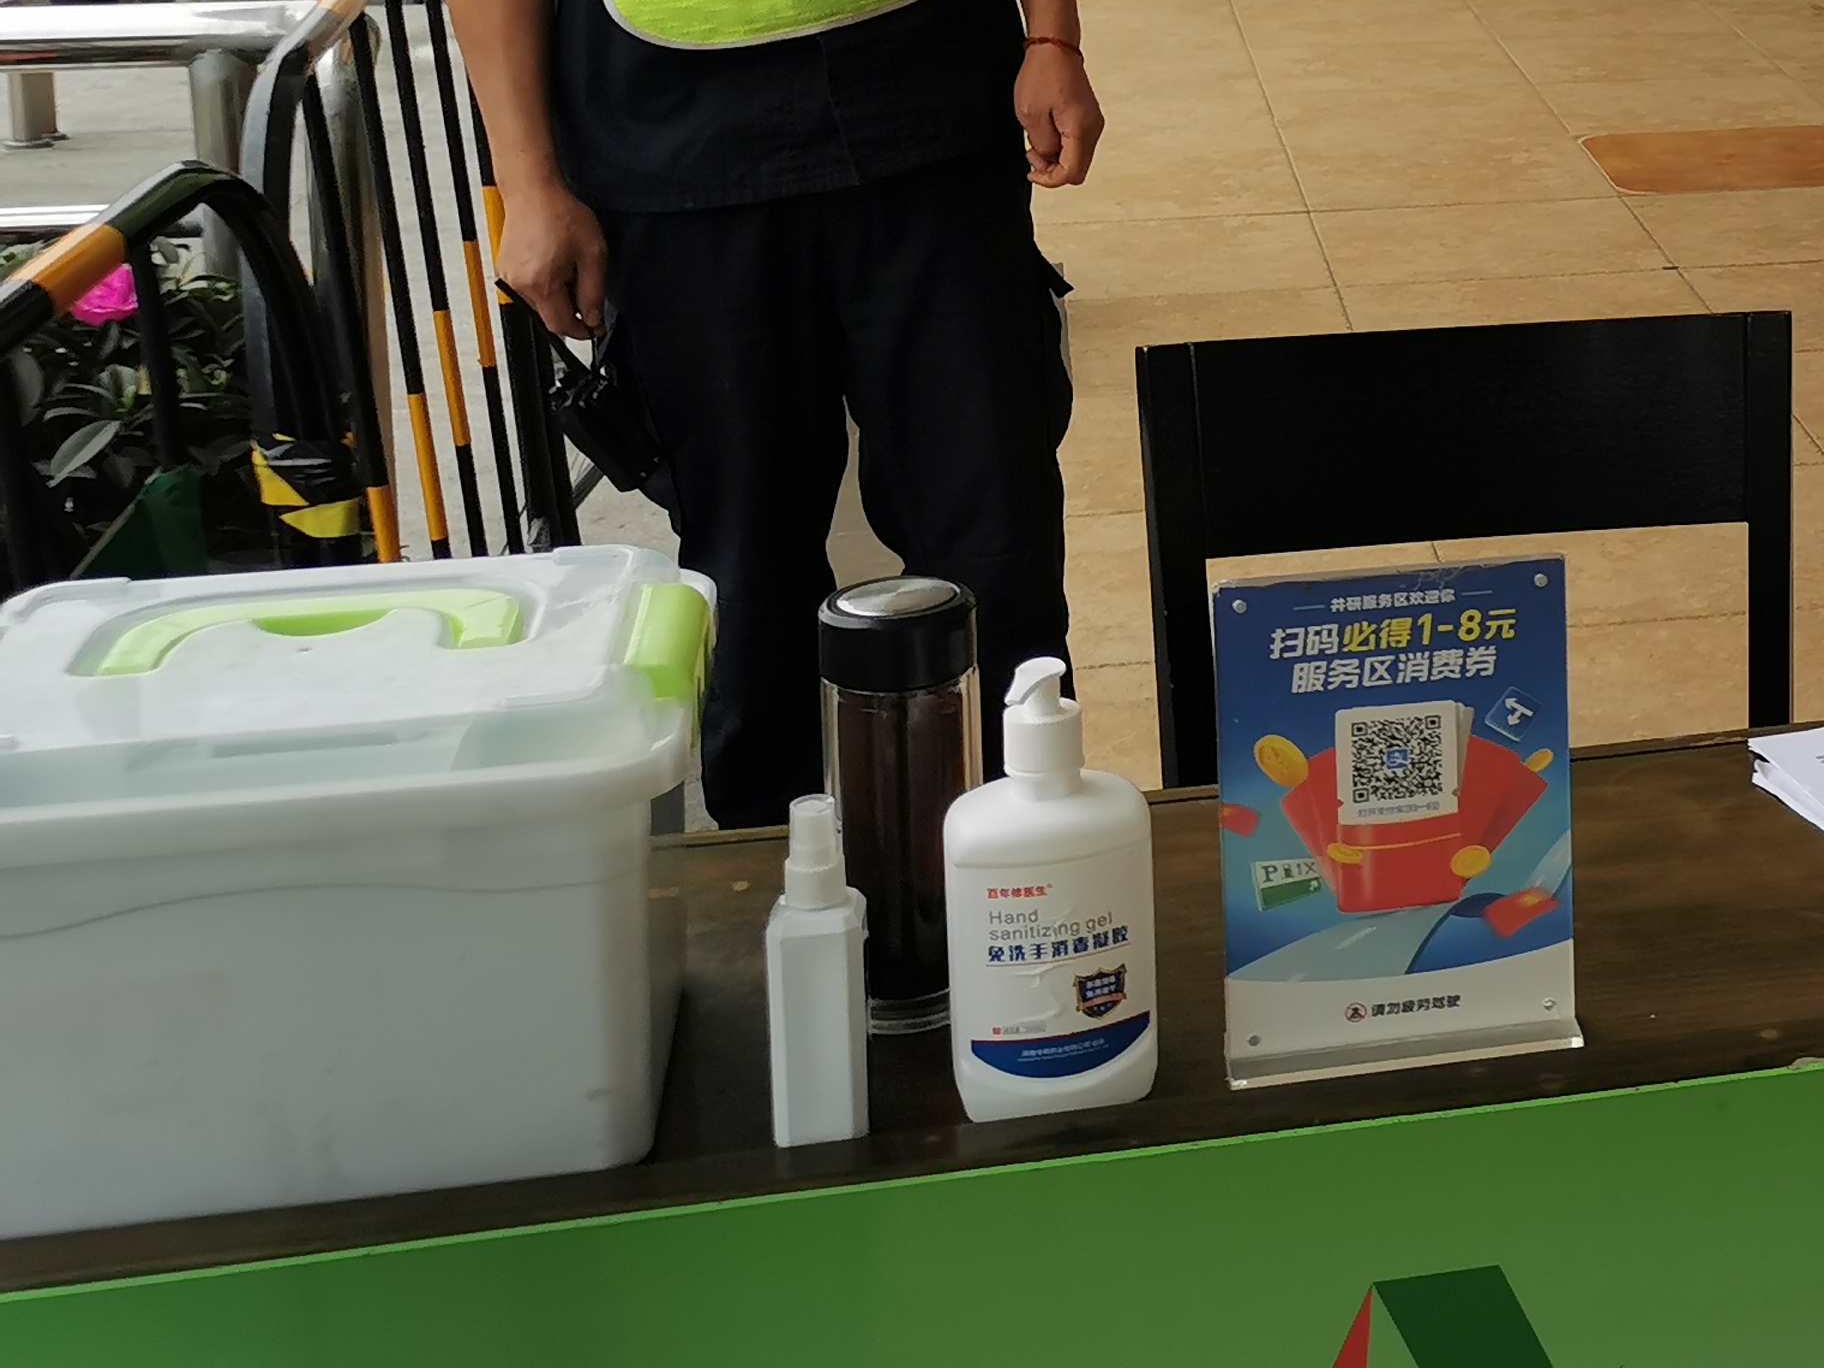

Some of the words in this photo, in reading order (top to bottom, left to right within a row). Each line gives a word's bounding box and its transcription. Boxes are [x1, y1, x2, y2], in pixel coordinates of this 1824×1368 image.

[1269, 608, 1517, 660] 扫码必得1-8元
[1290, 645, 1498, 694] 服务区消费券
[988, 908, 1039, 925] Hand
[988, 920, 1082, 942] sanitizing
[1085, 911, 1114, 934] gel
[988, 924, 1129, 963] 免洗手消毒凝胶
